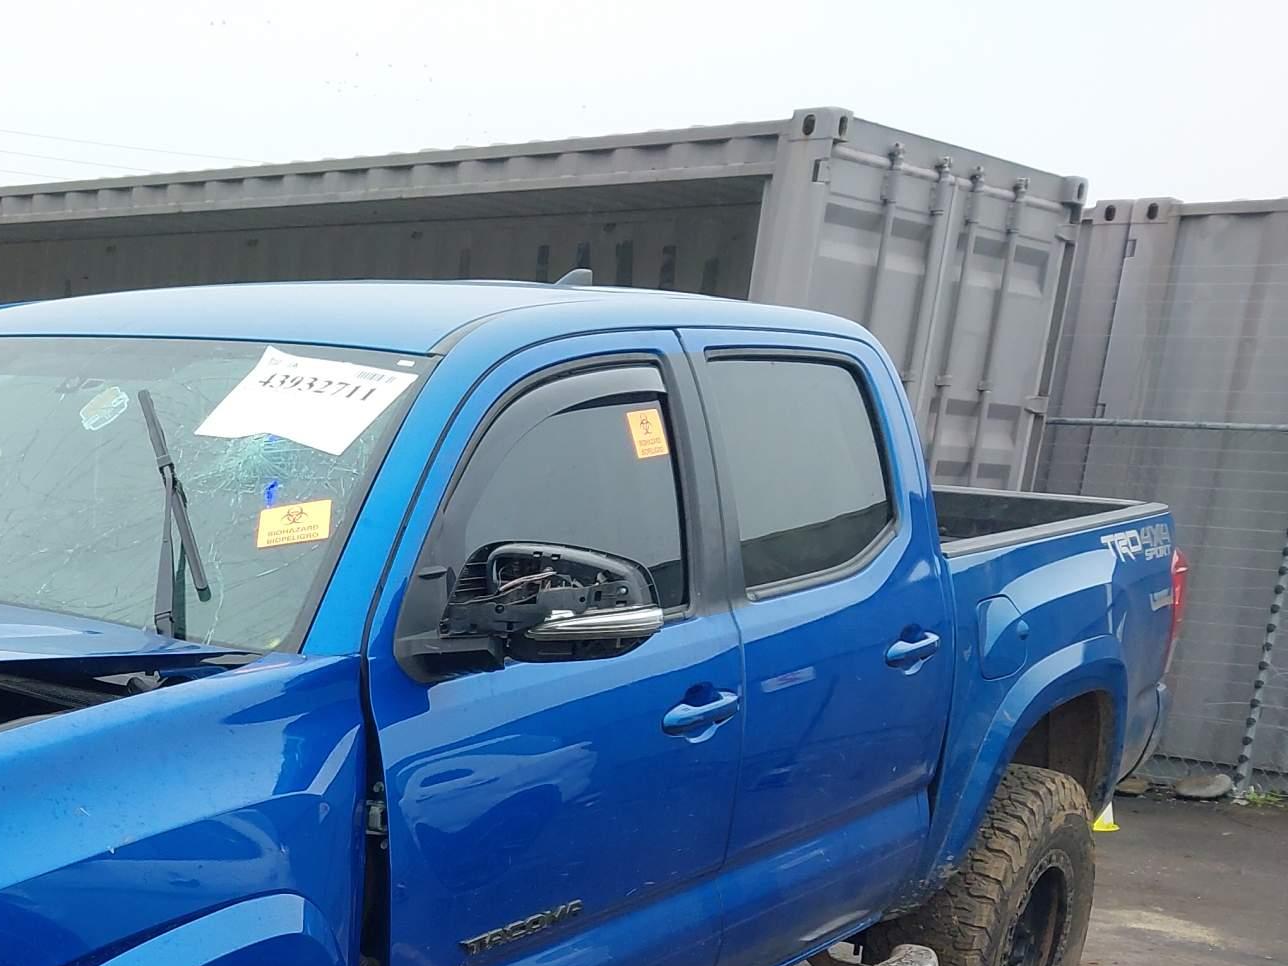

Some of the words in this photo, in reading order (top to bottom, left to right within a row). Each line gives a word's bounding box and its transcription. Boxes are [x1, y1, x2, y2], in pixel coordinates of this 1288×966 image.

[257, 372, 377, 401] 43932711
[1100, 529, 1143, 563] TRD
[1144, 544, 1171, 561] SPORT
